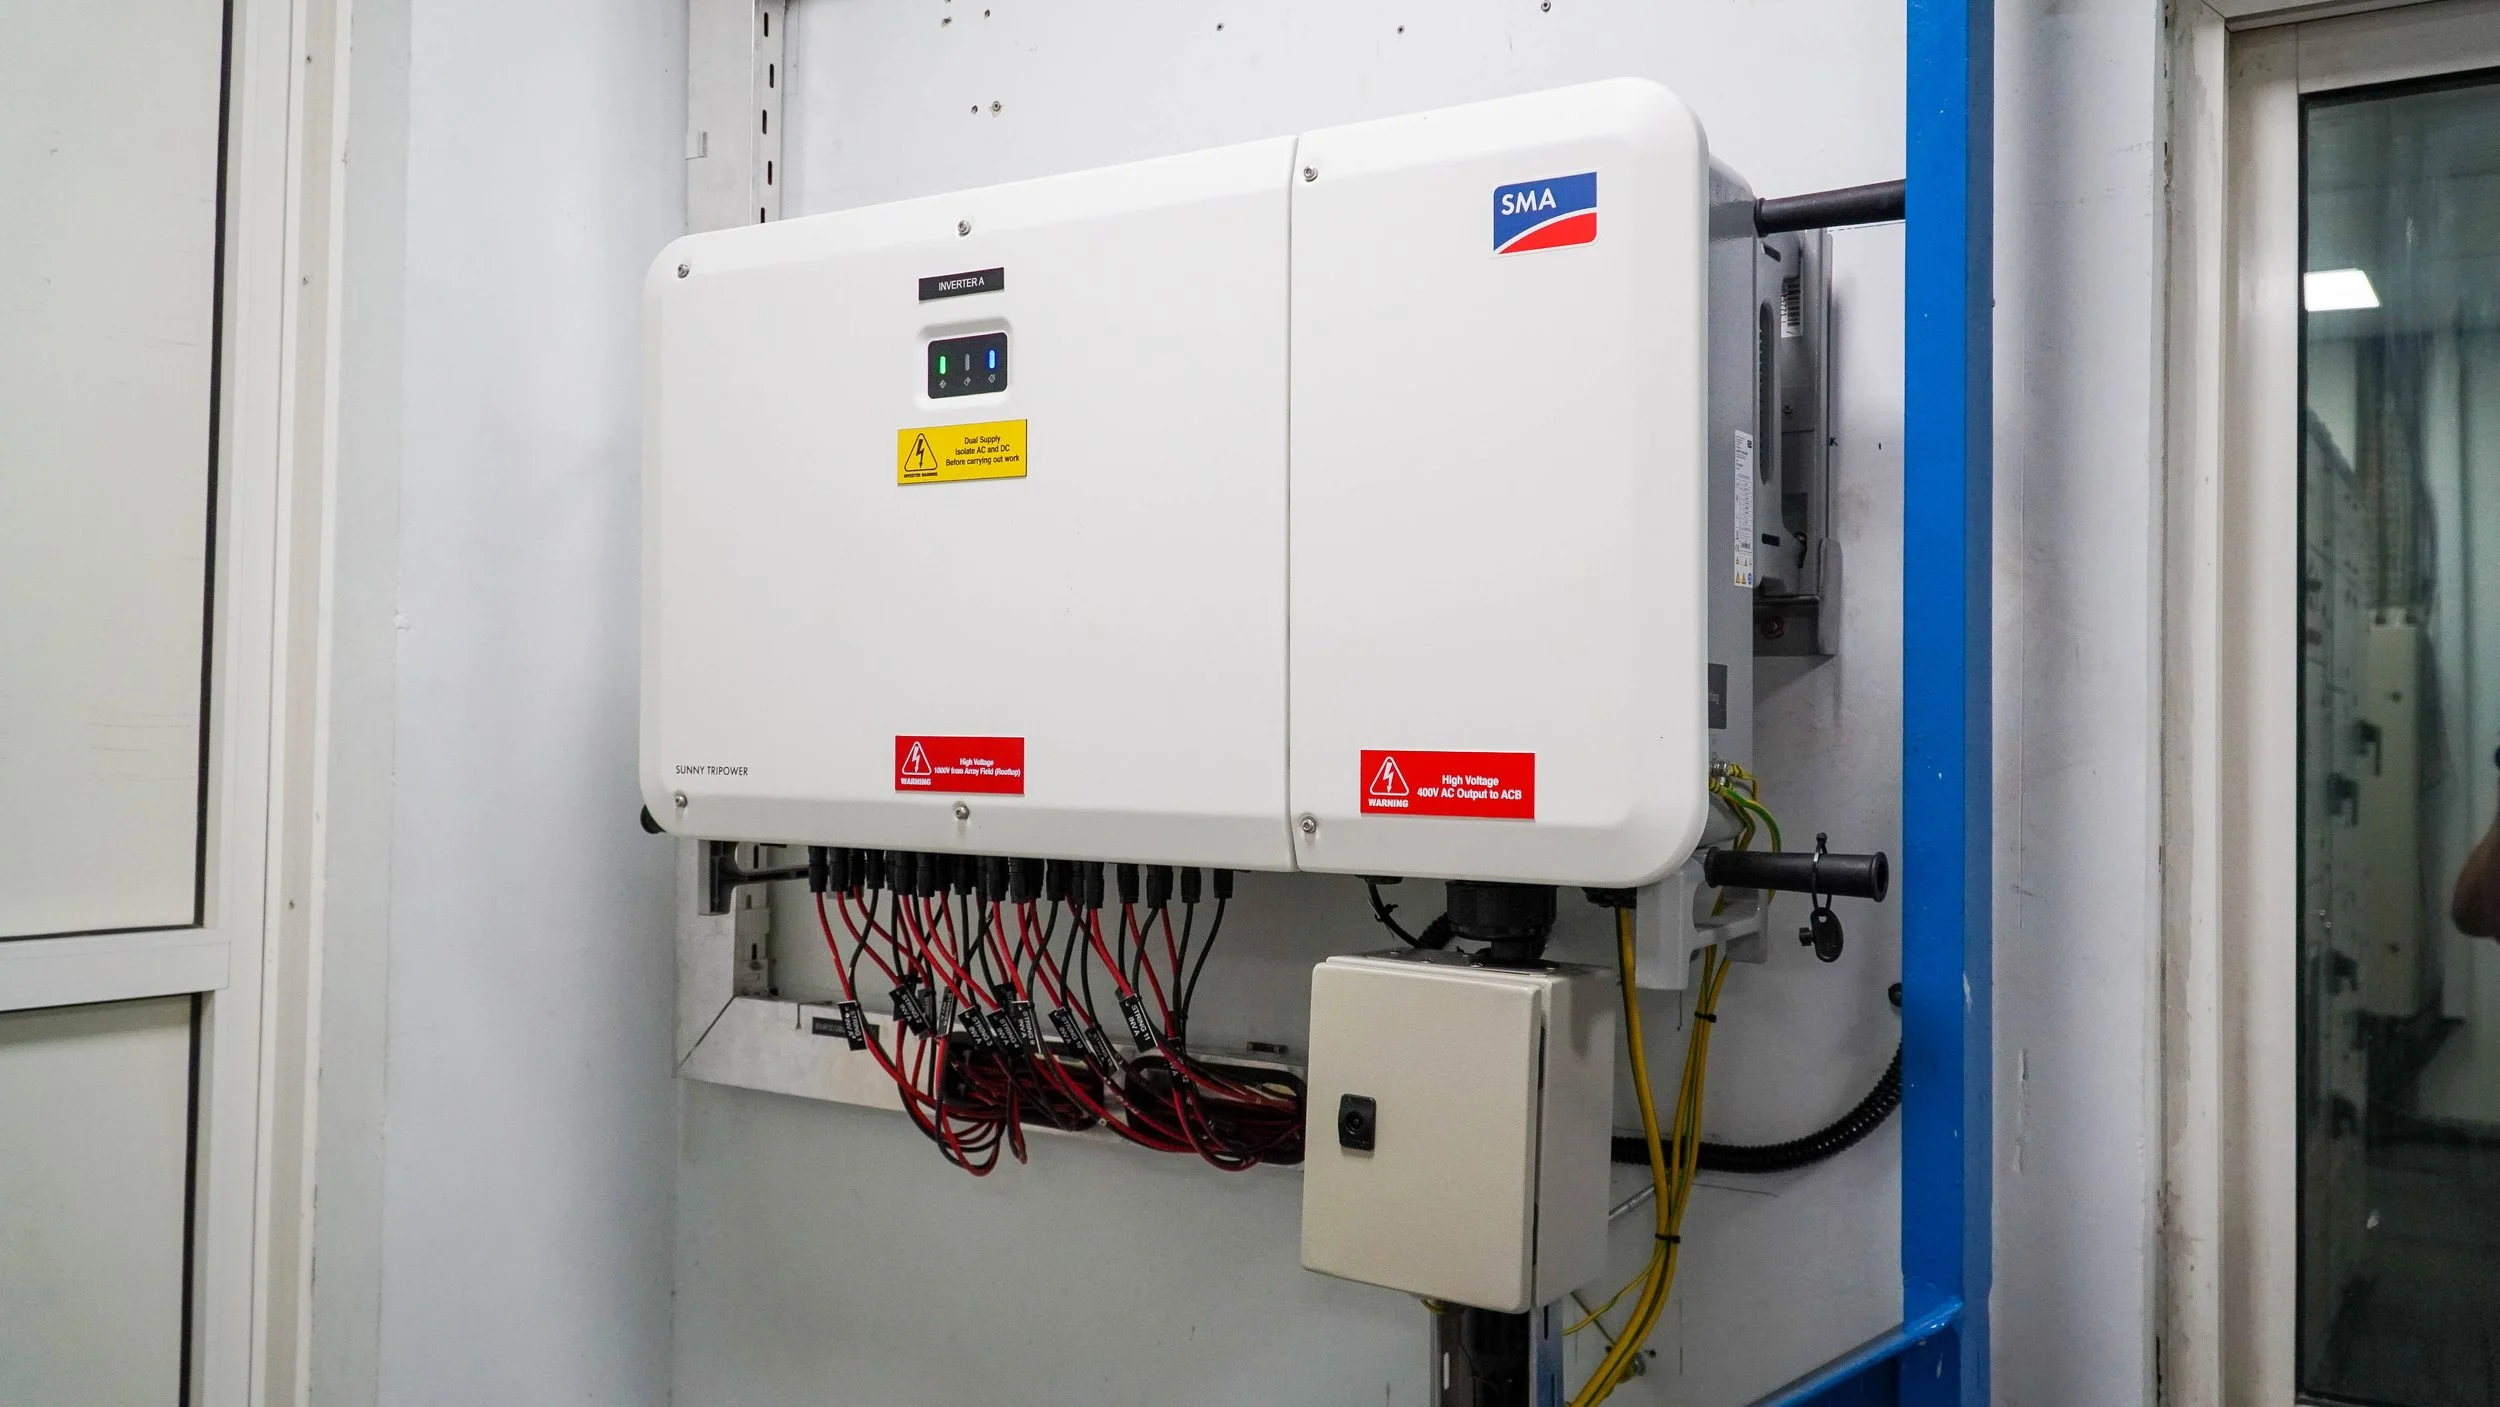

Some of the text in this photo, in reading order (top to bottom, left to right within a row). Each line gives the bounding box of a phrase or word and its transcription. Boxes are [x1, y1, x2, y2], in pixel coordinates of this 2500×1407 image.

[1501, 187, 1557, 216] SMA
[938, 276, 985, 291] INVERTER A
[964, 435, 1001, 445] Dual Supply
[955, 444, 1010, 456] Isolate AC and DC
[945, 454, 1020, 467] Before carrying out work
[959, 757, 995, 768] High Voltage
[675, 765, 748, 776] SUNNY TRIPOWER
[950, 767, 964, 775] from
[964, 767, 979, 776] Array
[979, 767, 993, 775] Field
[994, 768, 1021, 777] (Rooftop)
[900, 777, 932, 786] WARNING
[1441, 774, 1499, 788] High Voltage
[1416, 788, 1522, 801] 400V AC Output to ACB
[1368, 798, 1409, 808] WARNING
[899, 1004, 909, 1016] INV
[901, 993, 919, 1019] STRING
[972, 1016, 990, 1041] STRING
[1022, 1011, 1034, 1040] STRING
[1060, 1016, 1078, 1041] STRING
[1128, 1016, 1138, 1029] INV
[1131, 1004, 1151, 1041] STRING 11
[968, 1026, 979, 1038] INV
[996, 1027, 1007, 1039] INV
[1000, 1018, 1017, 1043] STRING
[1059, 1026, 1069, 1038] INV
